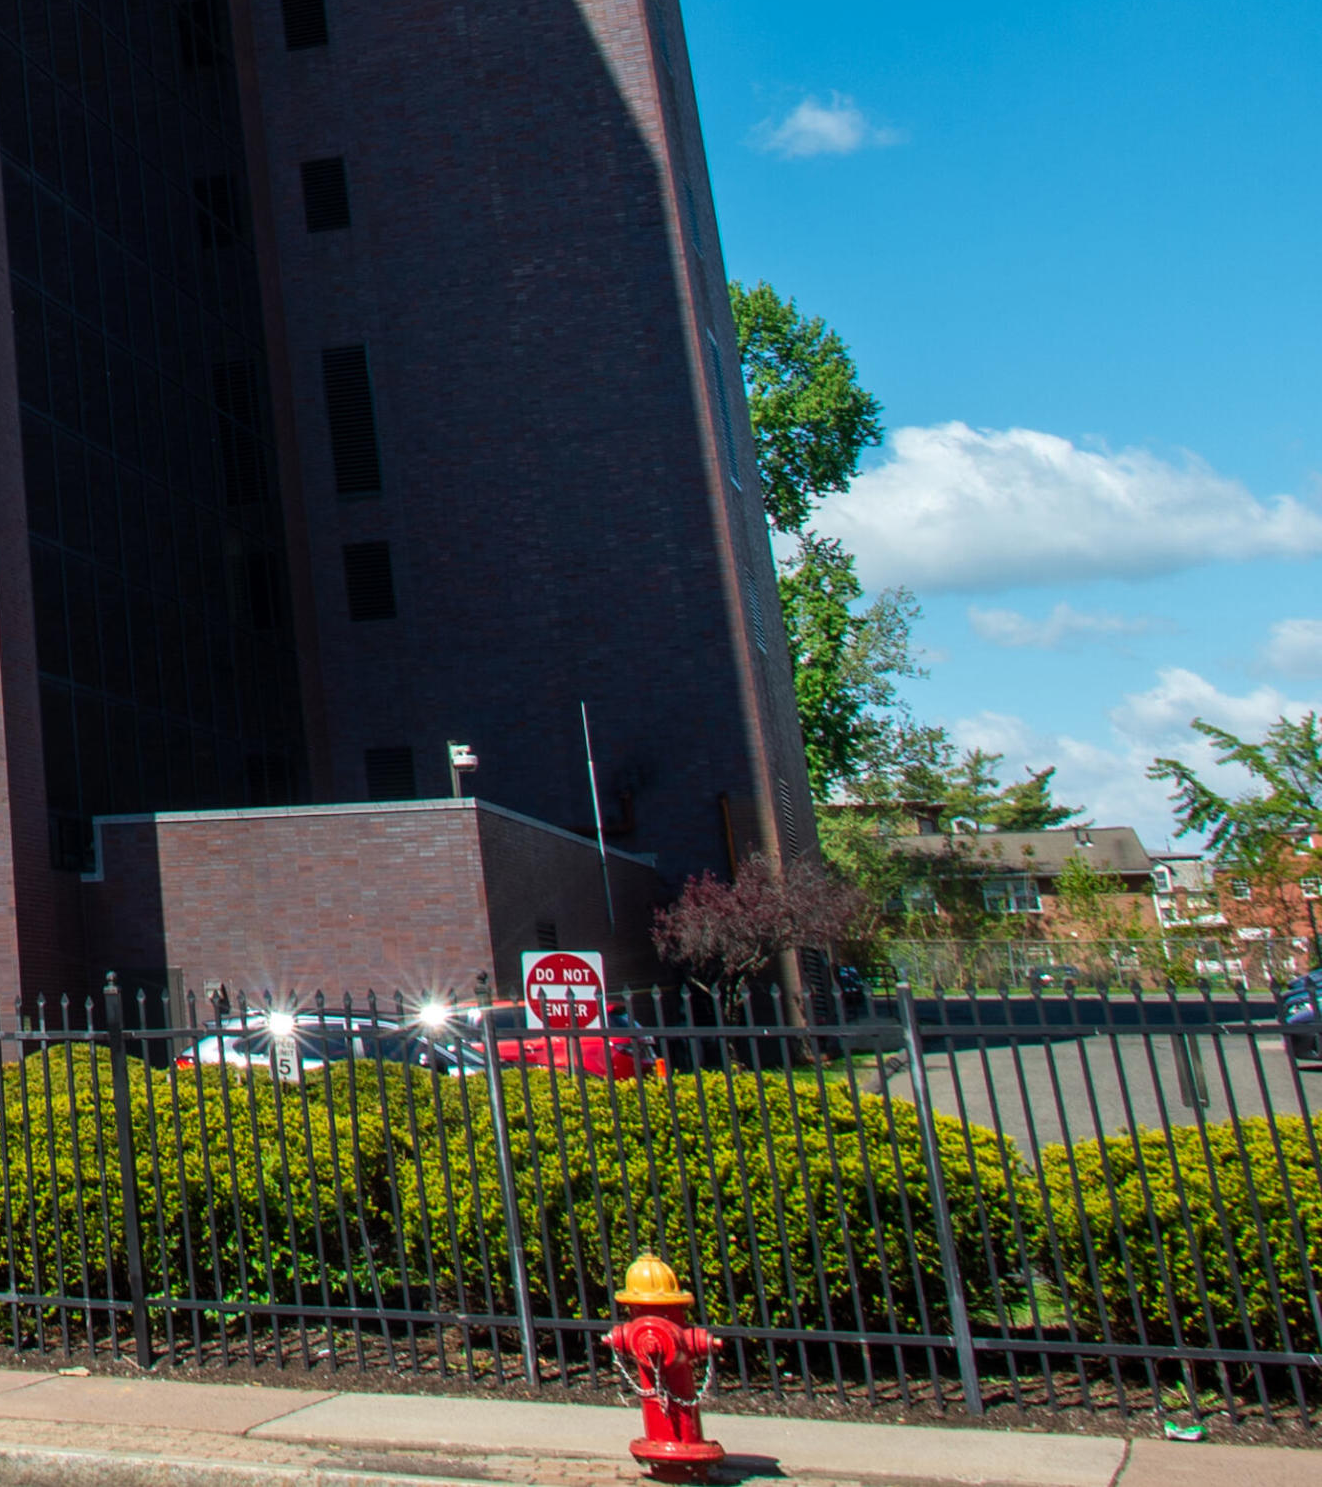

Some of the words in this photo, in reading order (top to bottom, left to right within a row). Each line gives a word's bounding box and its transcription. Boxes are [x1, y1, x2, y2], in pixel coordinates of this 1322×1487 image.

[535, 968, 555, 982] DO
[562, 968, 590, 982] NOT
[279, 1059, 291, 1075] 5
